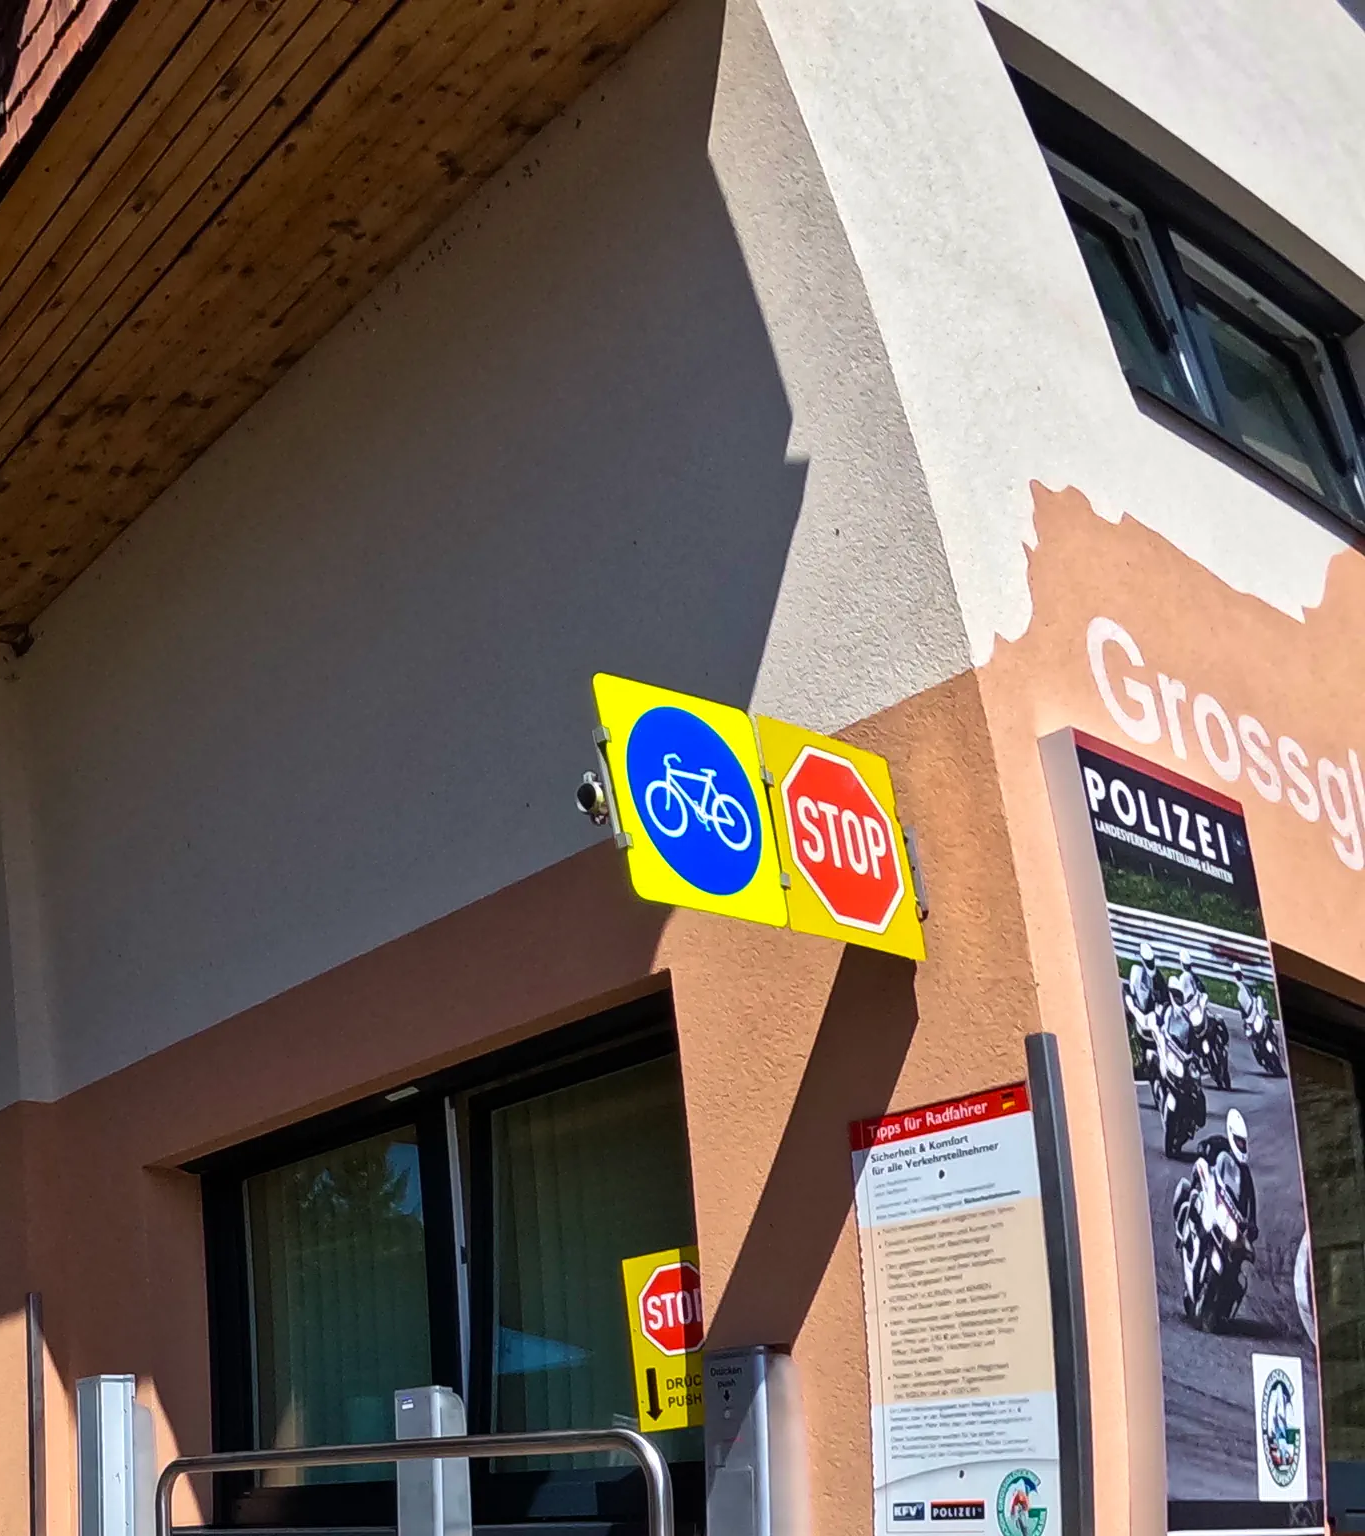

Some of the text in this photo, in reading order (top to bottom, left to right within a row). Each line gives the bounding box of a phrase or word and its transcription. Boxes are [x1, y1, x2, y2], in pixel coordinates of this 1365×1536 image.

[1083, 766, 1231, 866] POLIZEI
[796, 795, 886, 881] STOP
[868, 1101, 988, 1141] Tipps für Radfahrer
[871, 1135, 969, 1163] Sicherheit & Komfort
[872, 1142, 999, 1176] für alle Verkehrsteilnehmer
[933, 1507, 976, 1518] POLIZEI
